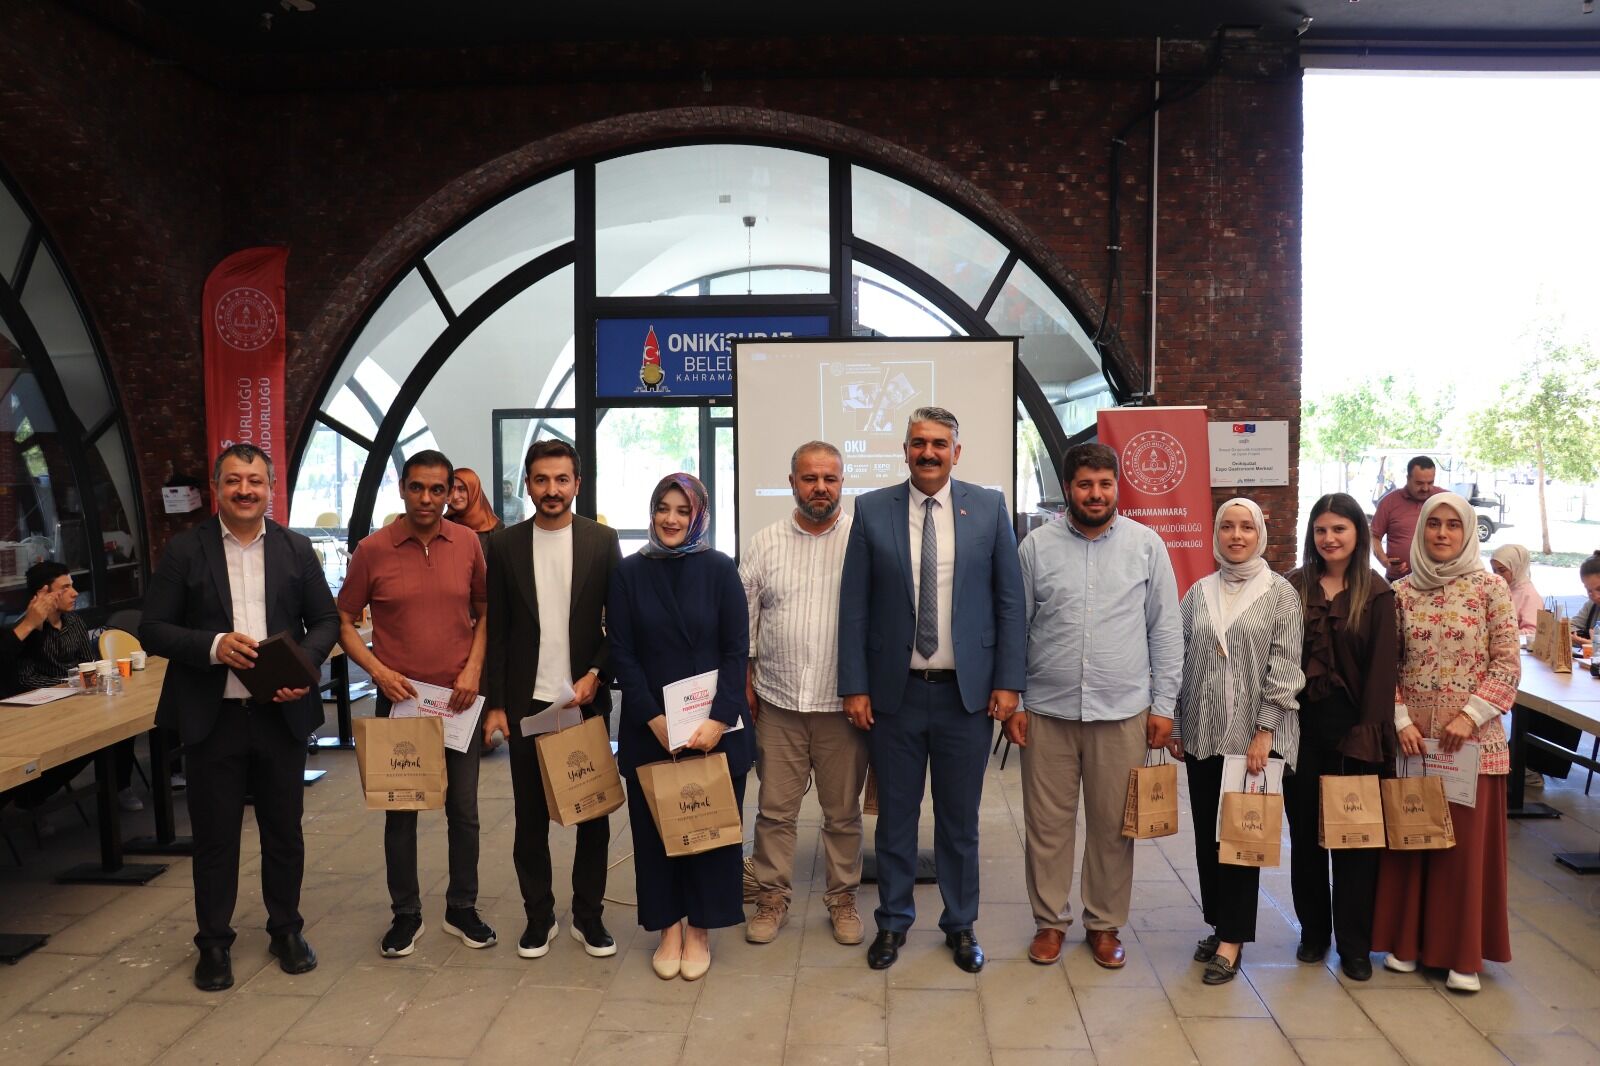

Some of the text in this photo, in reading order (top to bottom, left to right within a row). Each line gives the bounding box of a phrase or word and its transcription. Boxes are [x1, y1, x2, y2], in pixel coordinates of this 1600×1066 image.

[668, 332, 792, 354] ONiKi
[844, 440, 866, 452] OKU
[1122, 508, 1188, 518] KAHRAMANMARAŞ
[1160, 522, 1202, 533] MÜDÜRLÜĞÜ
